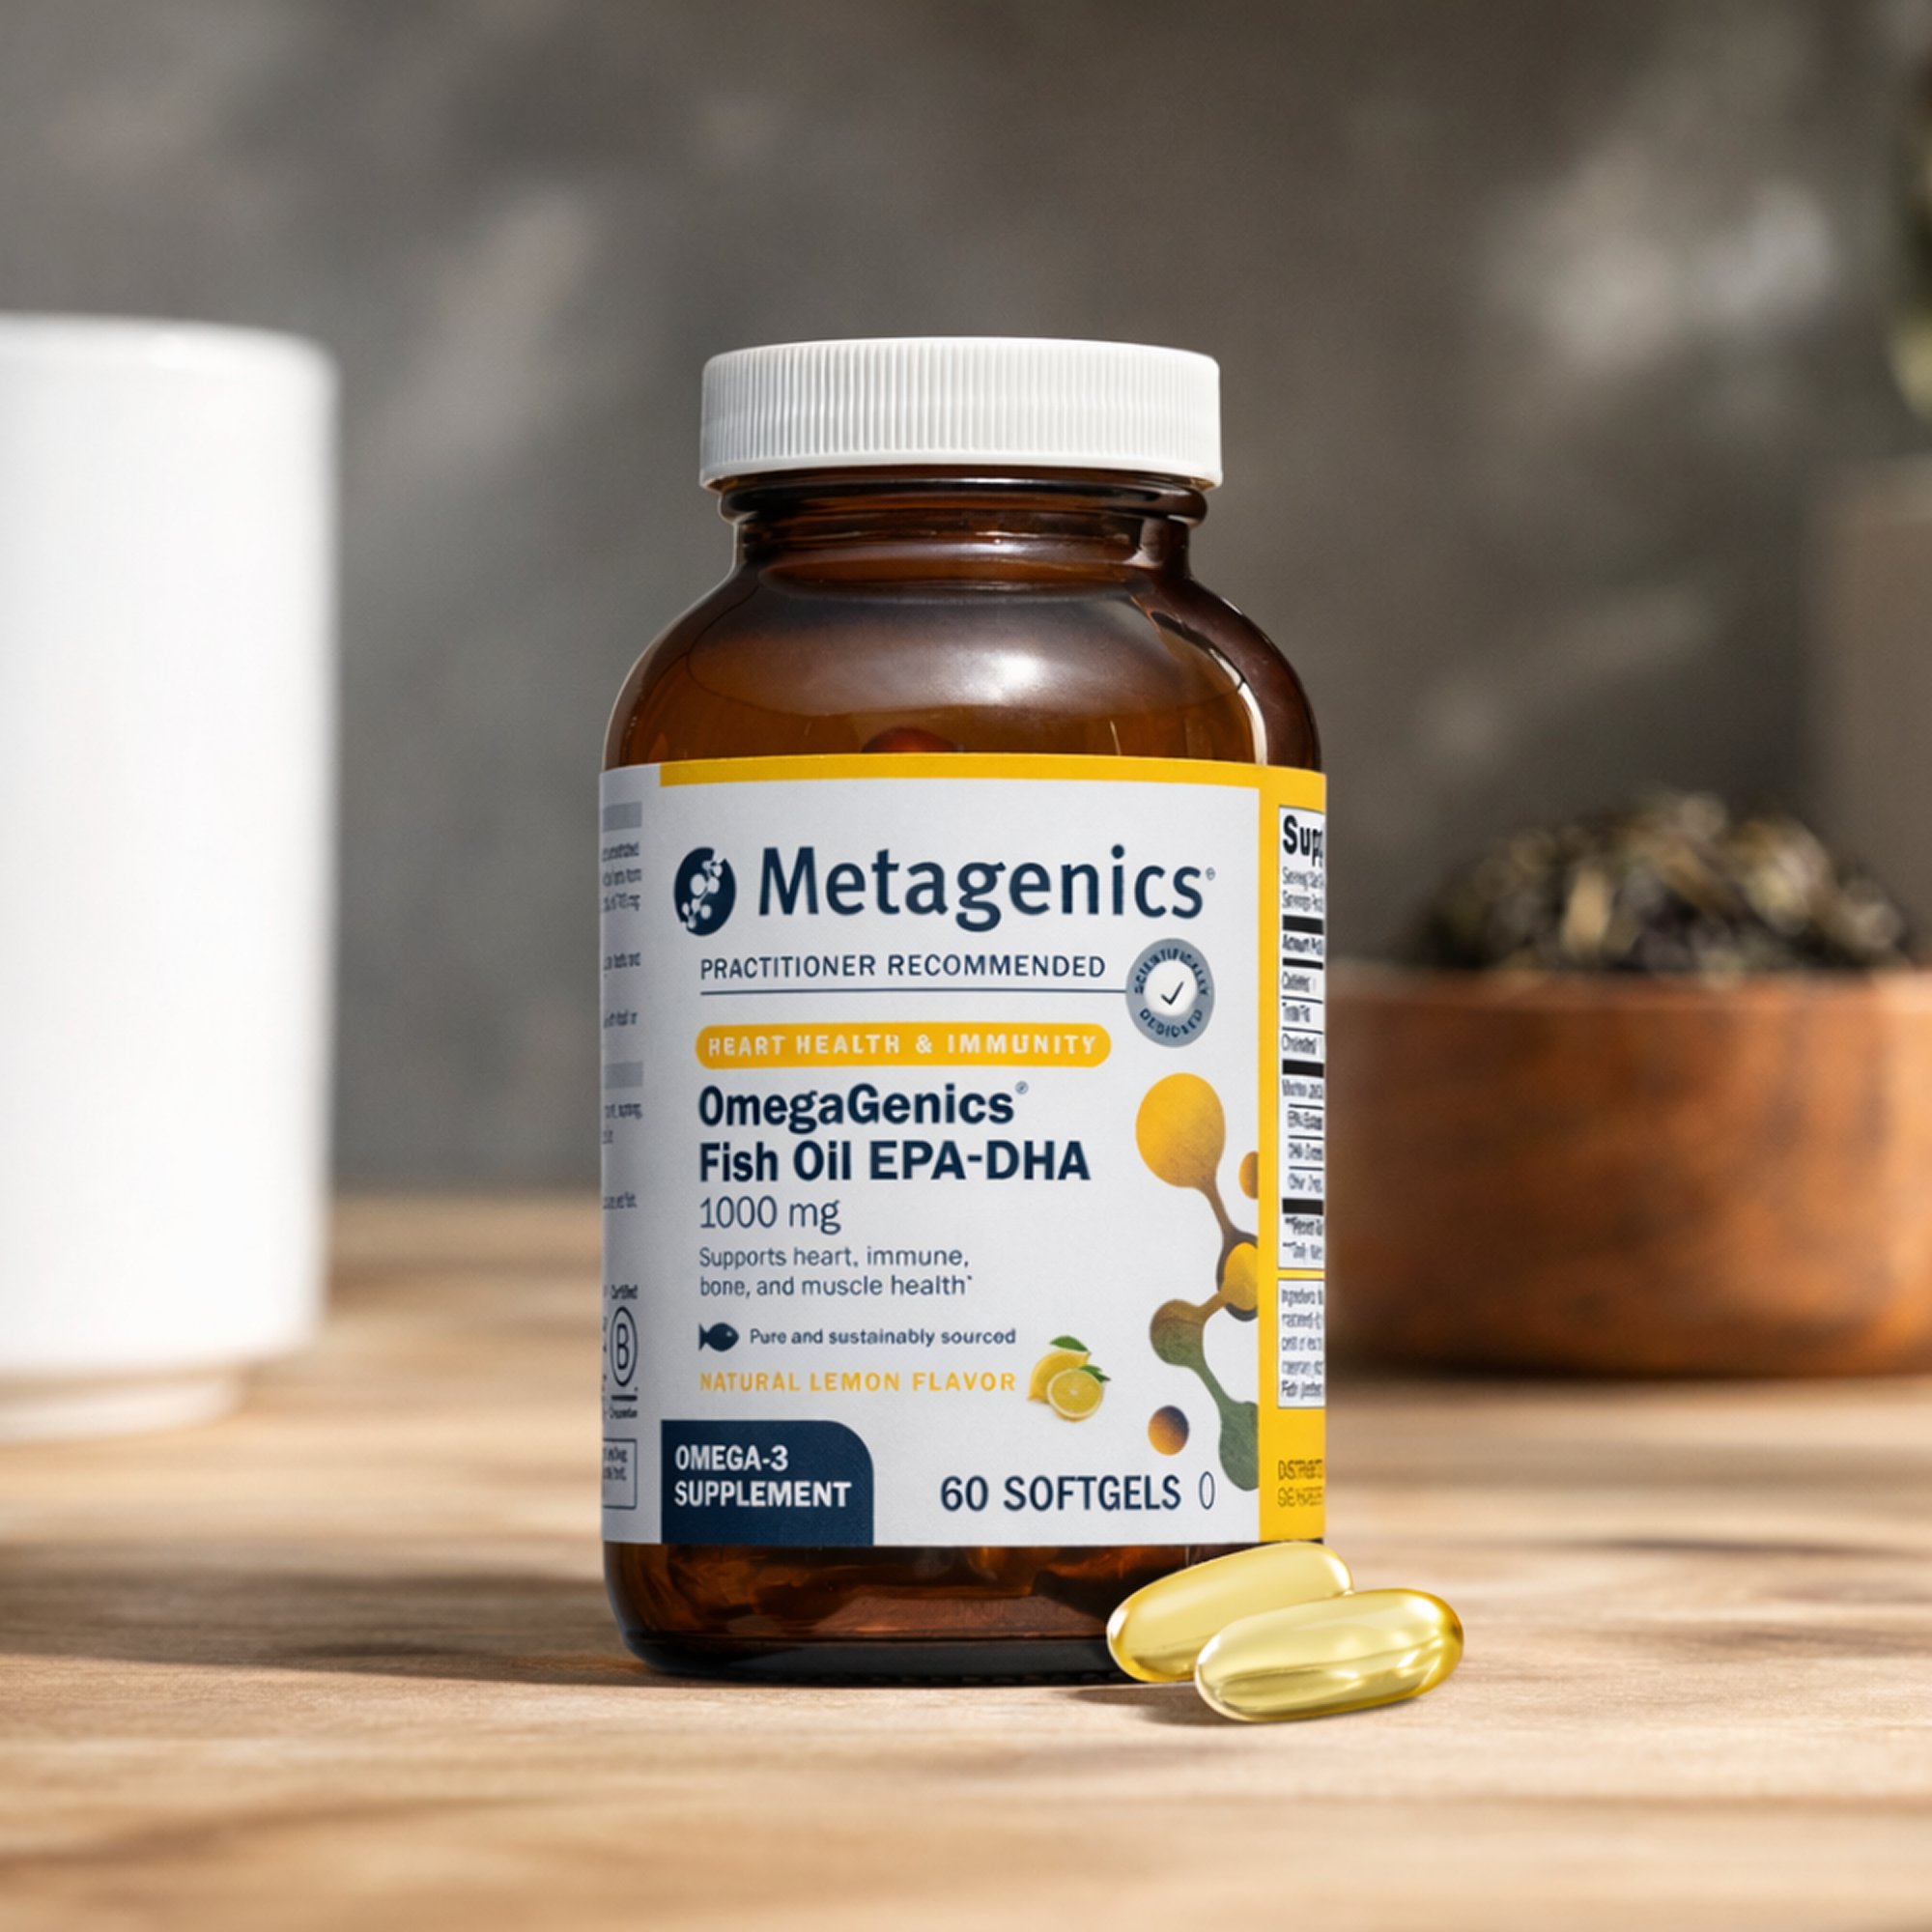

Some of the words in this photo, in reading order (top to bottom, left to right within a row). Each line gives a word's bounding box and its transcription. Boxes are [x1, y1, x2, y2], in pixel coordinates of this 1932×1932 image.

[700, 954, 875, 980] PRACTITIONER
[888, 952, 1105, 979] RECOMMENDED
[707, 1036, 785, 1057] HEART
[796, 1034, 899, 1055] HEALTH
[915, 1035, 933, 1054] &
[947, 1034, 1097, 1055] IMMUNITY
[699, 1141, 779, 1182] Fish
[792, 1140, 852, 1182] Oil
[870, 1139, 1091, 1181] EPA-DHA
[699, 1195, 778, 1230] 1000
[788, 1200, 841, 1236] mg
[699, 1247, 787, 1272] Supports
[867, 1245, 970, 1269] immune,
[699, 1276, 752, 1299] bone,
[756, 1275, 794, 1296] and
[802, 1275, 883, 1296] muscle
[750, 1328, 787, 1345] Pure
[791, 1327, 823, 1345] and
[829, 1328, 935, 1348] sustainably
[698, 1372, 801, 1393] NATURAL
[810, 1372, 900, 1393] LEMON
[912, 1371, 1016, 1392] FLAVOR
[675, 1445, 789, 1472] OMEGA-3
[674, 1480, 853, 1508] SUPPLEMENT
[941, 1475, 989, 1512] 60
[1003, 1474, 1182, 1512] SOFTGELS
